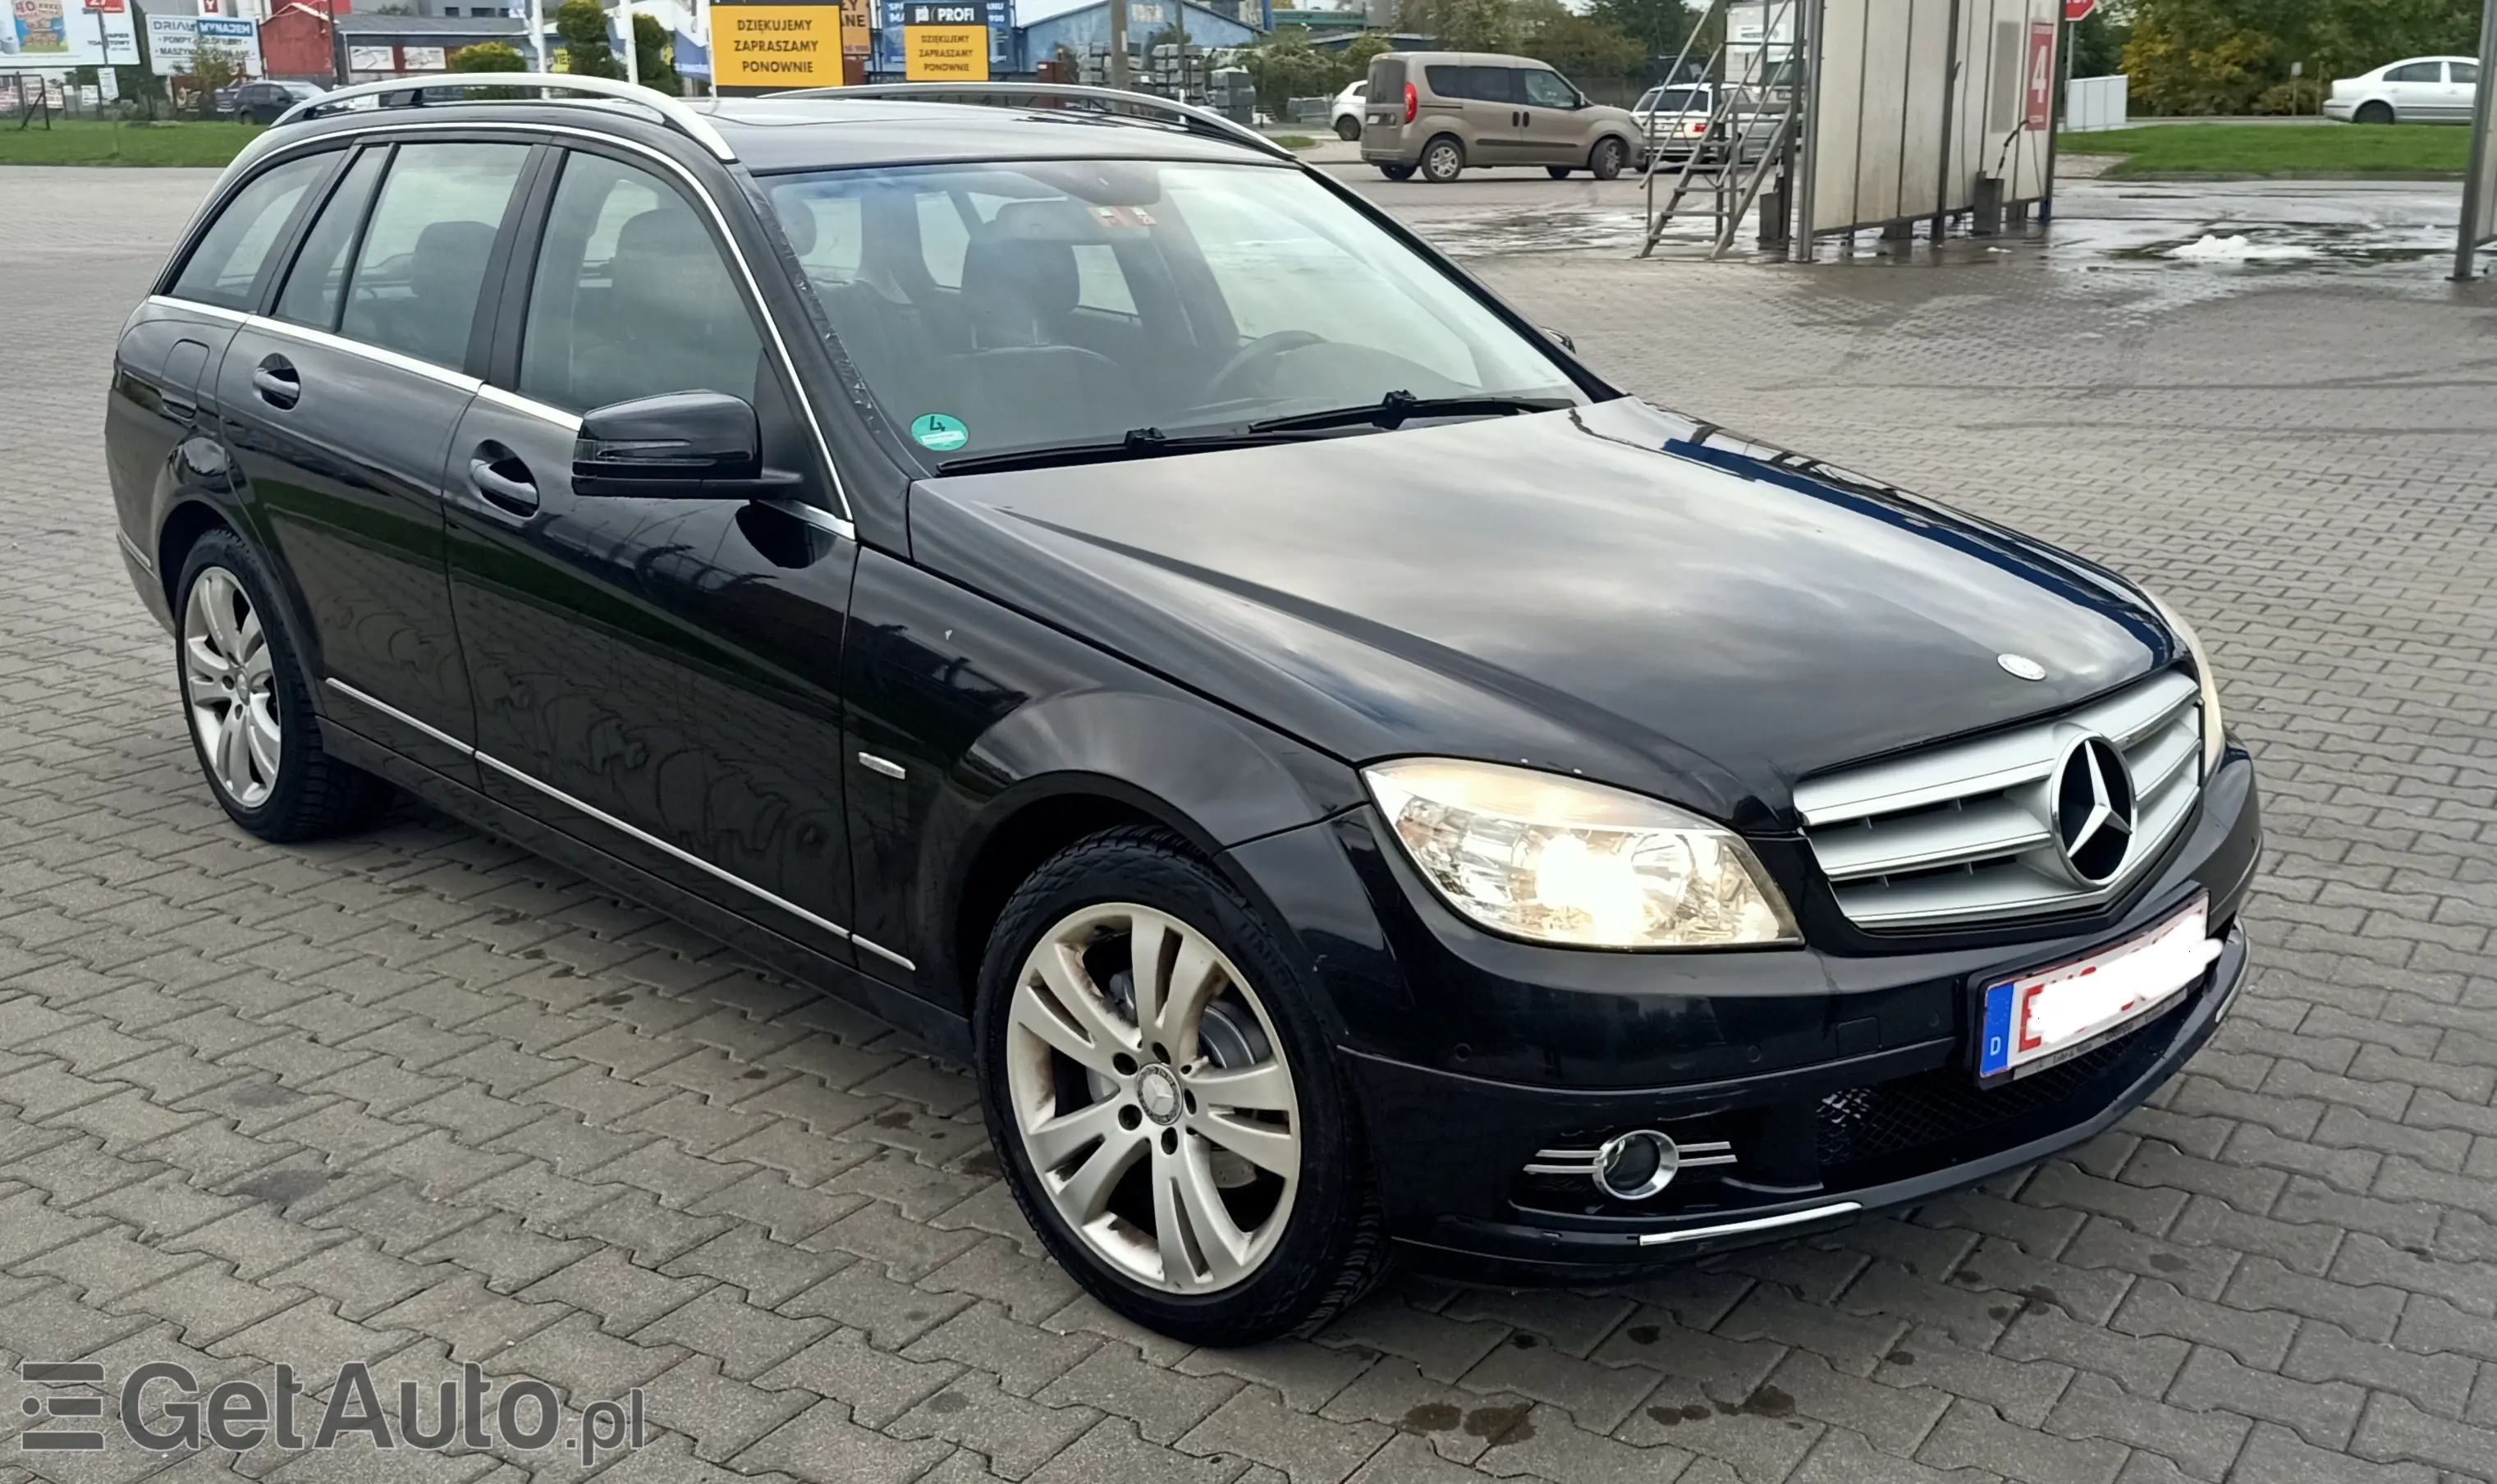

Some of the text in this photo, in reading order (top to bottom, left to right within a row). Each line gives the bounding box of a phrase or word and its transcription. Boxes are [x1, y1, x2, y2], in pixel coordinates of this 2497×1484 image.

[937, 7, 974, 21] PROFI
[737, 20, 813, 34] DZIĘKUJEMY
[734, 40, 818, 52] ZAPRASZAMY
[921, 35, 969, 44] DZIĘKUJEMY
[919, 49, 974, 57] ZAPRASZAMY
[742, 61, 813, 73] PONOWNIE
[923, 63, 969, 71] PONOWNIE
[2032, 45, 2048, 103] 4
[929, 415, 946, 432] 4
[1990, 1036, 2001, 1056] D
